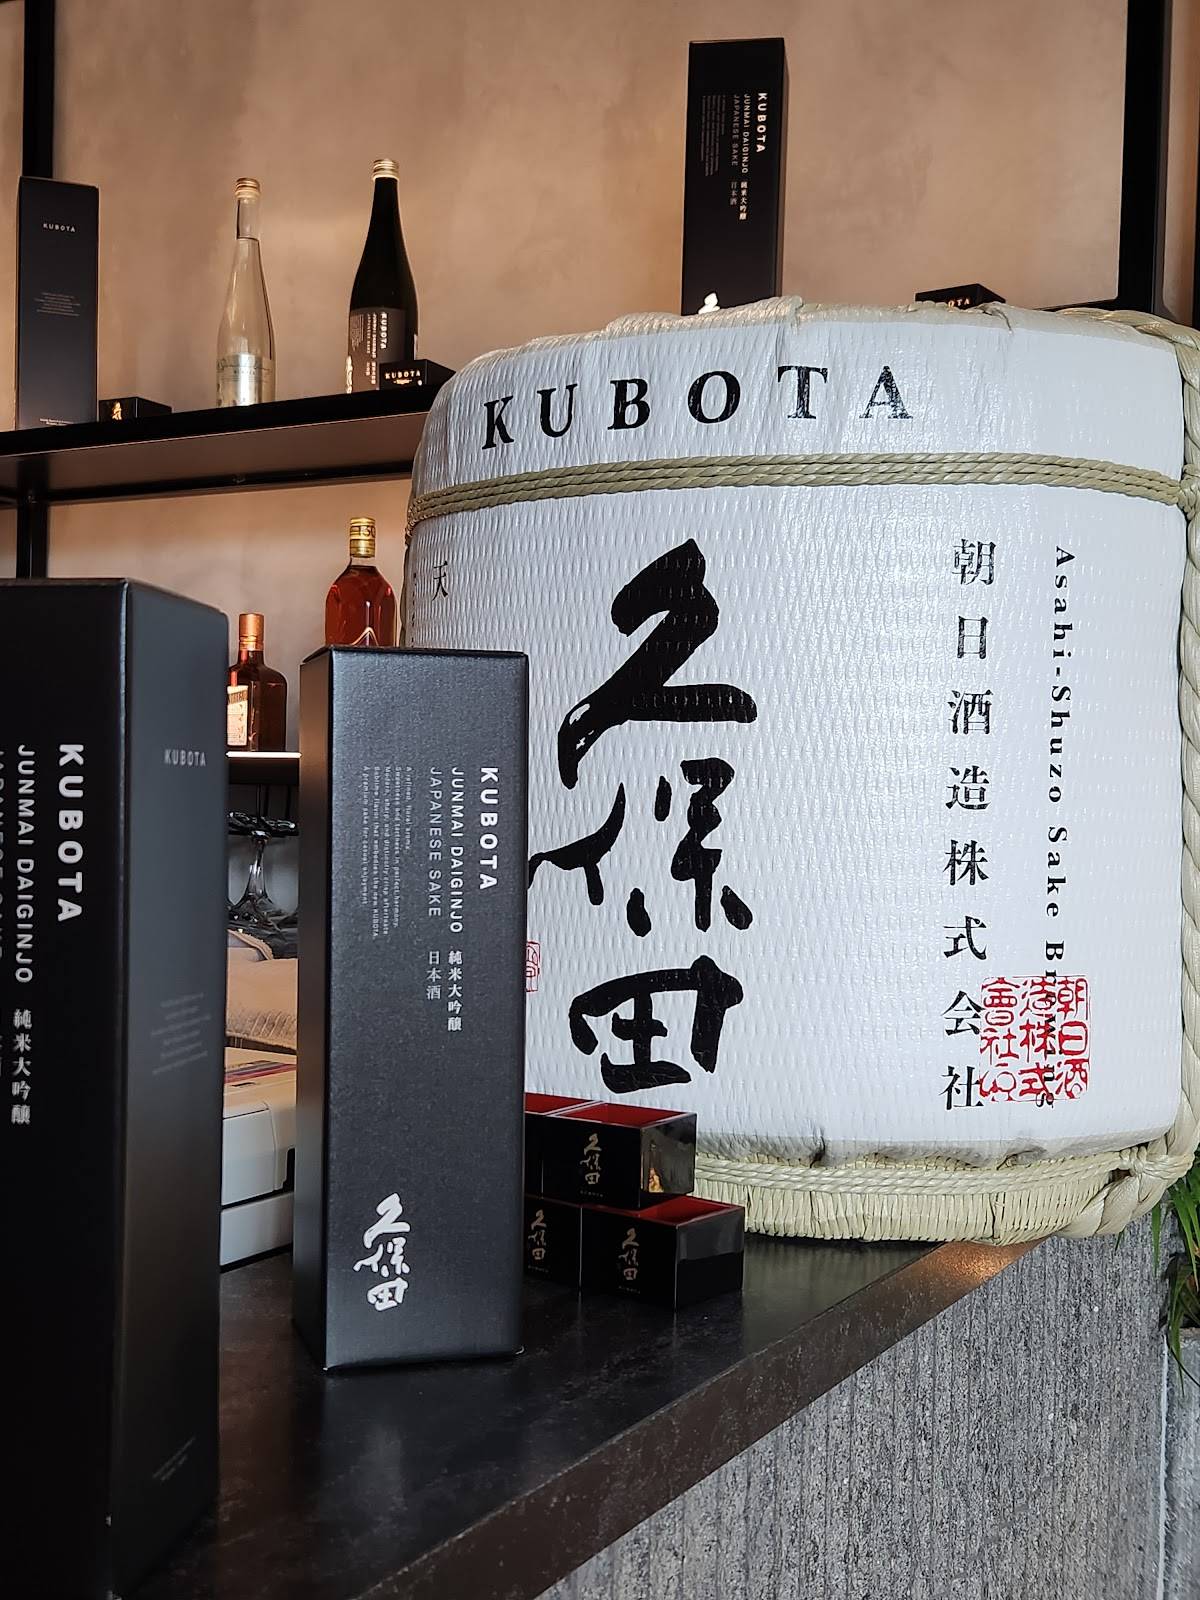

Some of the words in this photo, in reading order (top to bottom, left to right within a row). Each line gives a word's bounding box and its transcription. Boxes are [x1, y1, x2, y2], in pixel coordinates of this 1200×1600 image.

[743, 94, 751, 127] JUNMAI
[756, 93, 768, 152] KUBOTA
[731, 143, 739, 166] SAKE
[741, 132, 750, 173] DAIGINJO
[43, 222, 76, 232] KUBOTA
[385, 370, 421, 379] KUBOTA
[481, 365, 914, 449] KUBOTA
[1049, 546, 1075, 803] Asahi-Shuzo
[164, 749, 206, 767] KUBOTA
[17, 744, 35, 846] JUNMAI
[428, 766, 443, 861] JAPANESE
[450, 766, 464, 838] JUNMAI
[479, 766, 499, 890] KUBOTA
[527, 537, 757, 1094] 久保田
[938, 538, 996, 1110] 朝日酒造株式会社
[57, 743, 84, 922] KUBOTA
[428, 865, 442, 917] SAKE
[450, 846, 464, 933] DAIGINJO
[1046, 826, 1068, 917] Sake
[15, 858, 34, 983] DAIGINJO
[426, 950, 441, 1000] 日本酒
[579, 1132, 603, 1185] 久保田
[353, 1192, 411, 1312] 久保田
[528, 1208, 547, 1260] 久保田
[617, 1227, 640, 1280] 久保田
